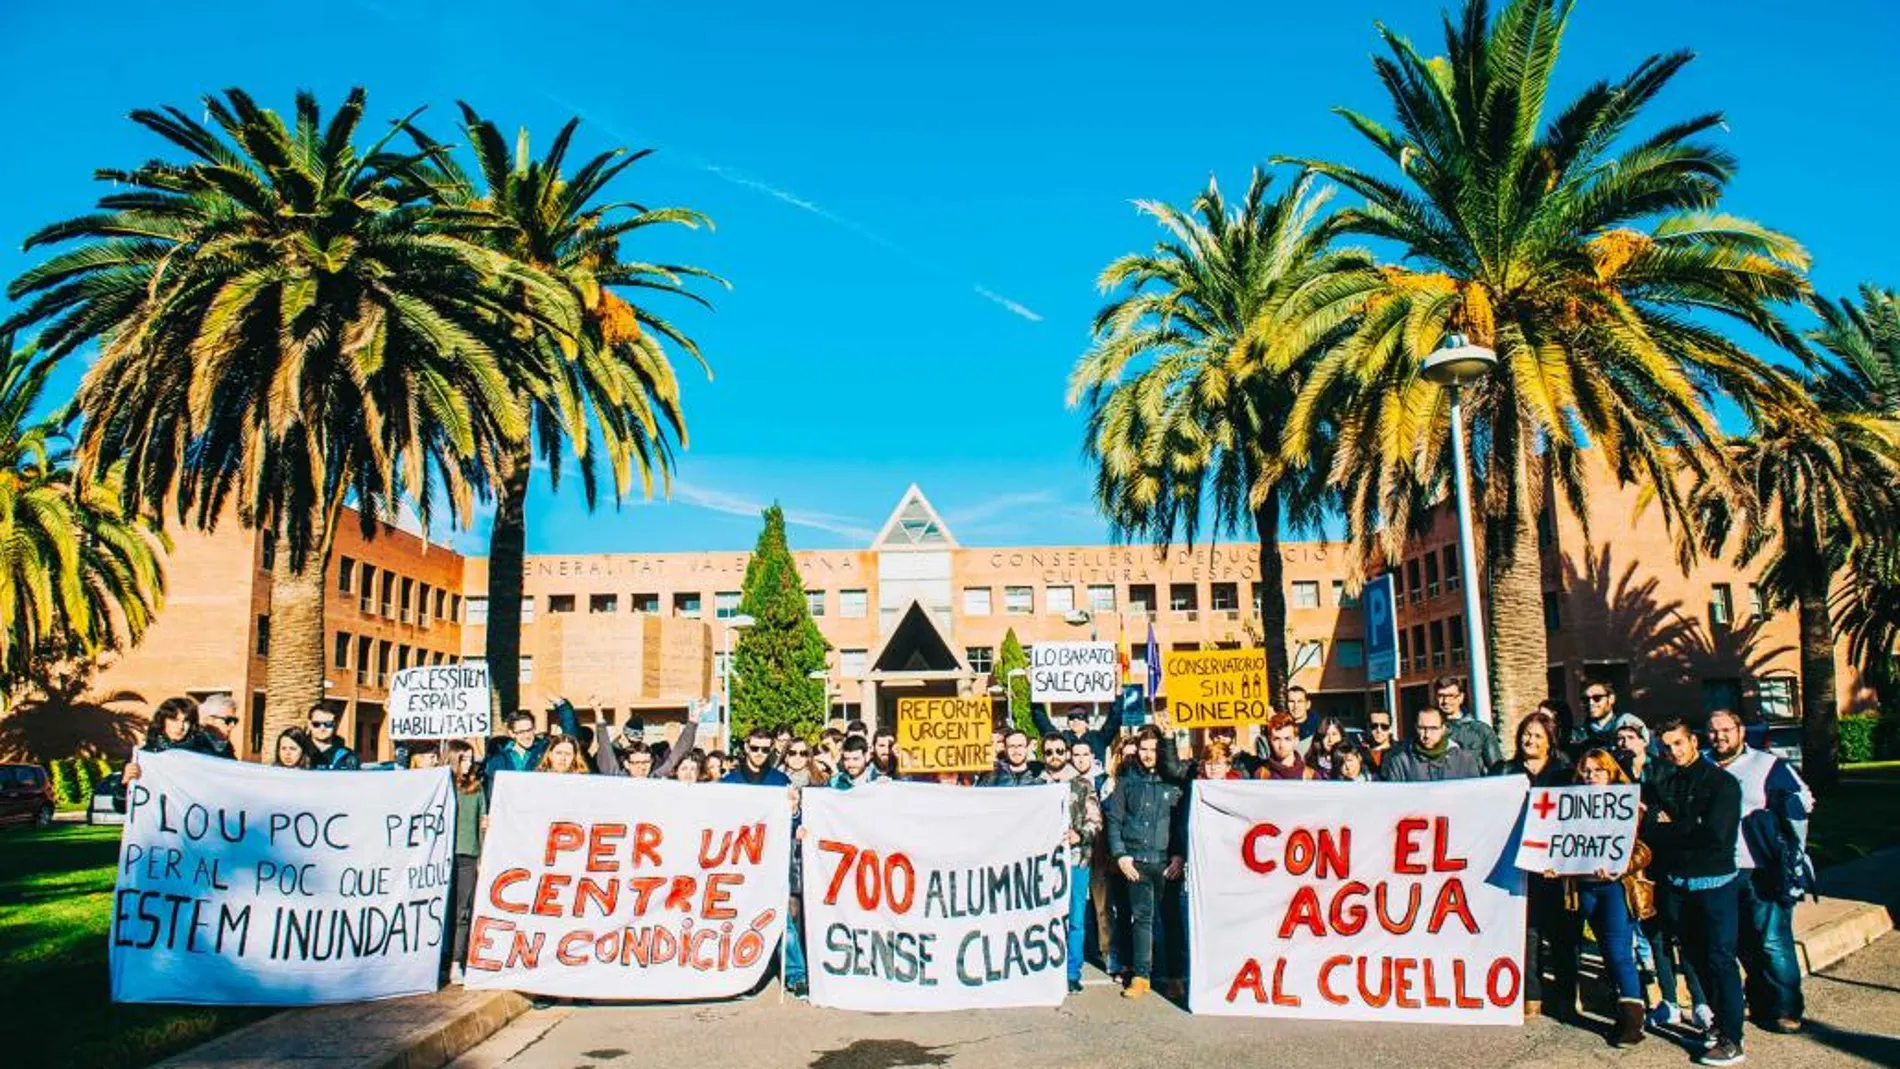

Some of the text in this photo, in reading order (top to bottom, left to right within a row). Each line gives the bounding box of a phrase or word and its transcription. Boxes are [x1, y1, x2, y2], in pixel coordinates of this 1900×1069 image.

[524, 555, 665, 576] ENERALITAT
[1042, 569, 1150, 583] CULTURA
[1035, 648, 1114, 667] LO BARATO
[1168, 657, 1265, 677] CONSERVATORIO
[393, 667, 487, 691] NECESSITEM
[1035, 670, 1113, 693] SALE CARO
[1200, 680, 1234, 697] SIN
[408, 692, 467, 711] ESPAIS
[901, 700, 991, 720] REFORMA
[1176, 700, 1265, 723] DINERO
[391, 713, 488, 736] HABILITATS
[909, 722, 985, 741] URGENT
[901, 744, 993, 768] DEL CENTRE
[130, 785, 246, 843] PLOU
[270, 812, 349, 849] POC
[544, 821, 767, 872] PER UN
[1241, 816, 1467, 879] CON EL
[125, 844, 182, 881] PER
[194, 858, 228, 890] AL
[256, 861, 316, 896] POC
[340, 868, 390, 897] QUE
[818, 839, 1069, 919] 700 ALUMNES
[489, 867, 745, 920] CENTRE
[1277, 877, 1481, 939] AGUA
[114, 888, 443, 961] ESTEM INUNDATS
[467, 916, 546, 971] EN
[822, 922, 939, 986] SENSE
[1225, 955, 1521, 1009] AL CUELLO
